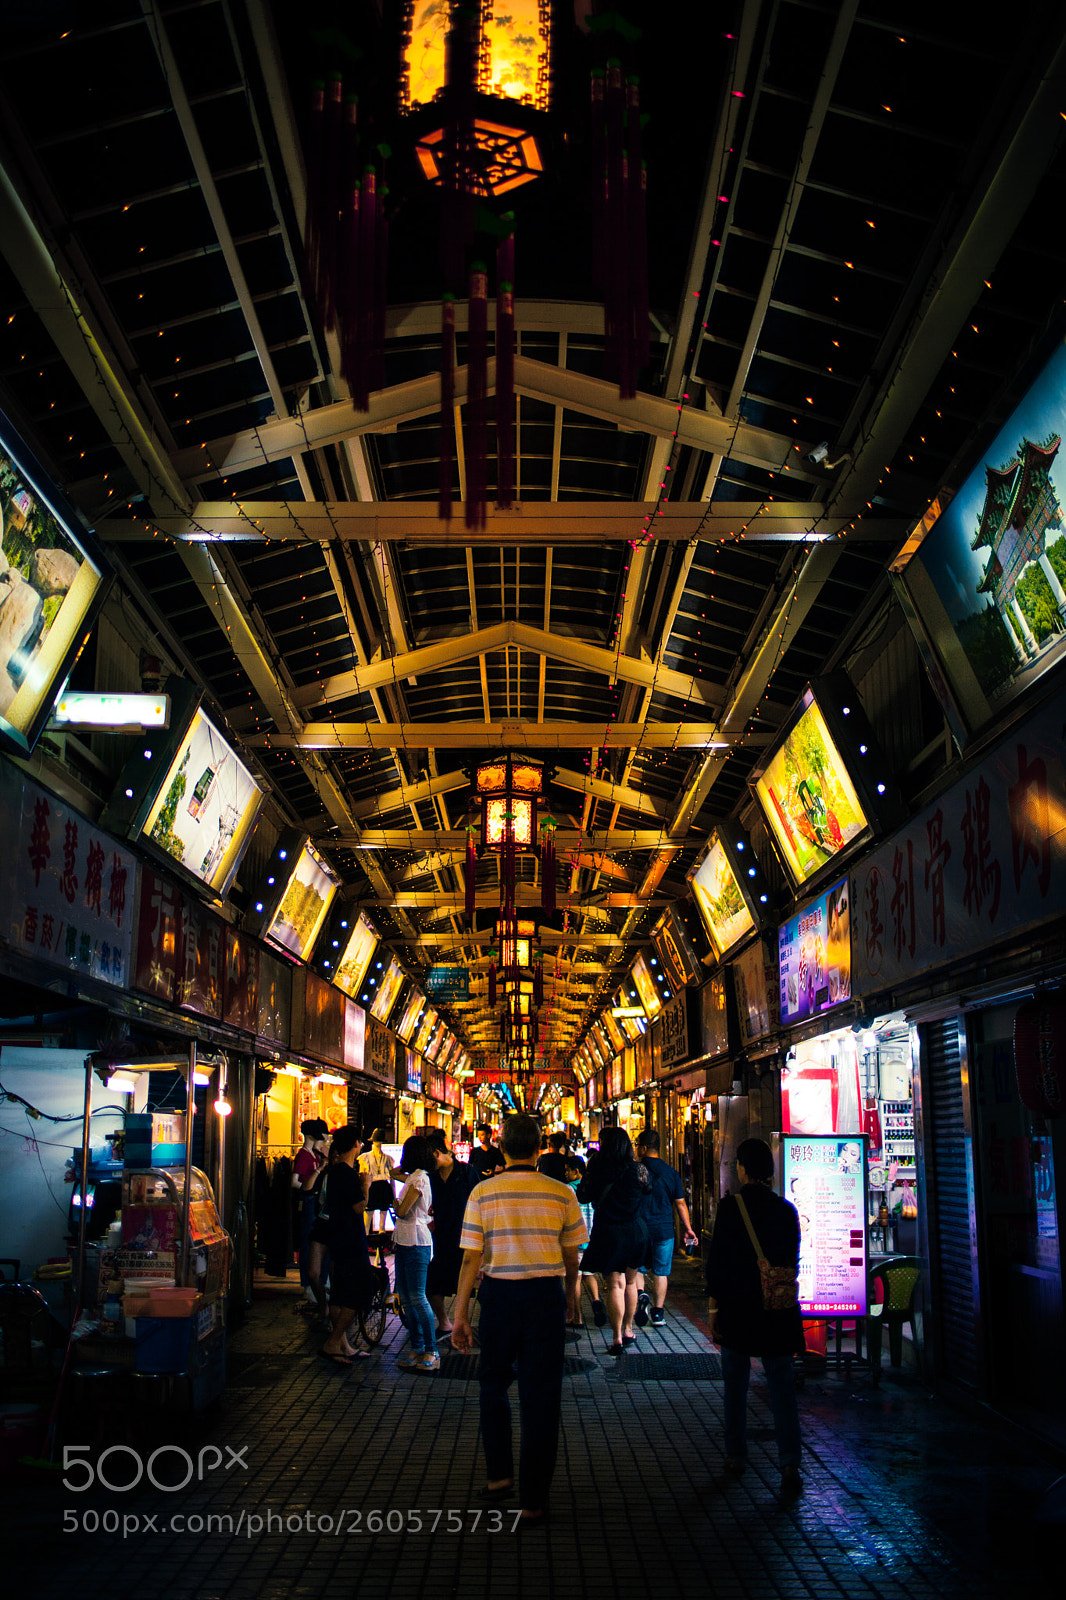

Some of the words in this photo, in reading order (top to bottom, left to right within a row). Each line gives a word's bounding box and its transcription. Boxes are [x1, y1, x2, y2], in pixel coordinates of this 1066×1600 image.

[28, 796, 128, 928] 華慧檳榔
[790, 1144, 813, 1161] 婷玲
